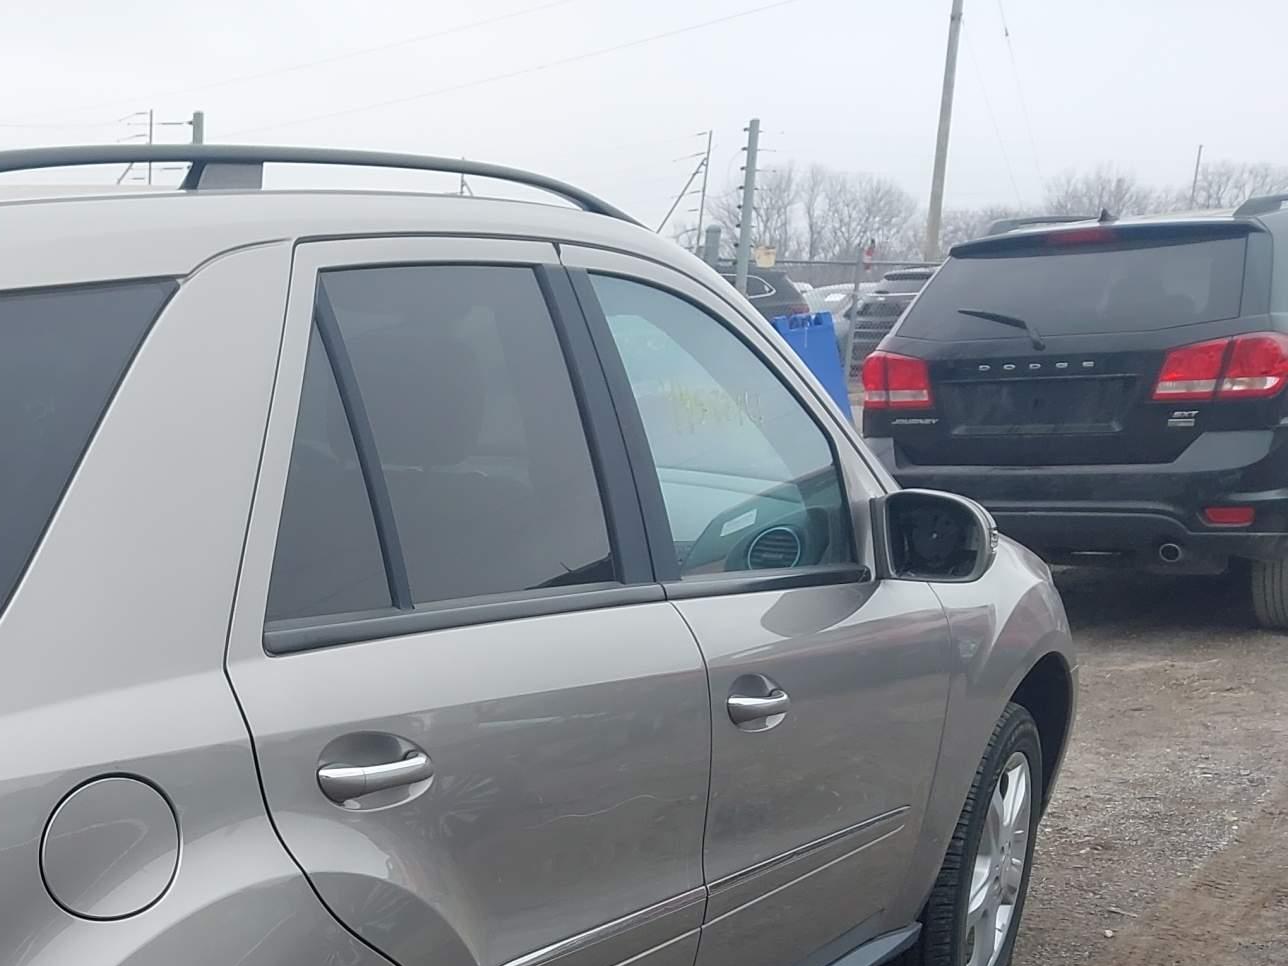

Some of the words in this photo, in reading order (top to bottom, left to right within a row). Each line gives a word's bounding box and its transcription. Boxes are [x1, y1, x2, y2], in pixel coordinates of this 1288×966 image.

[978, 360, 1095, 372] DODGE
[1172, 410, 1200, 419] SXT
[890, 417, 940, 426] JOURNEY
